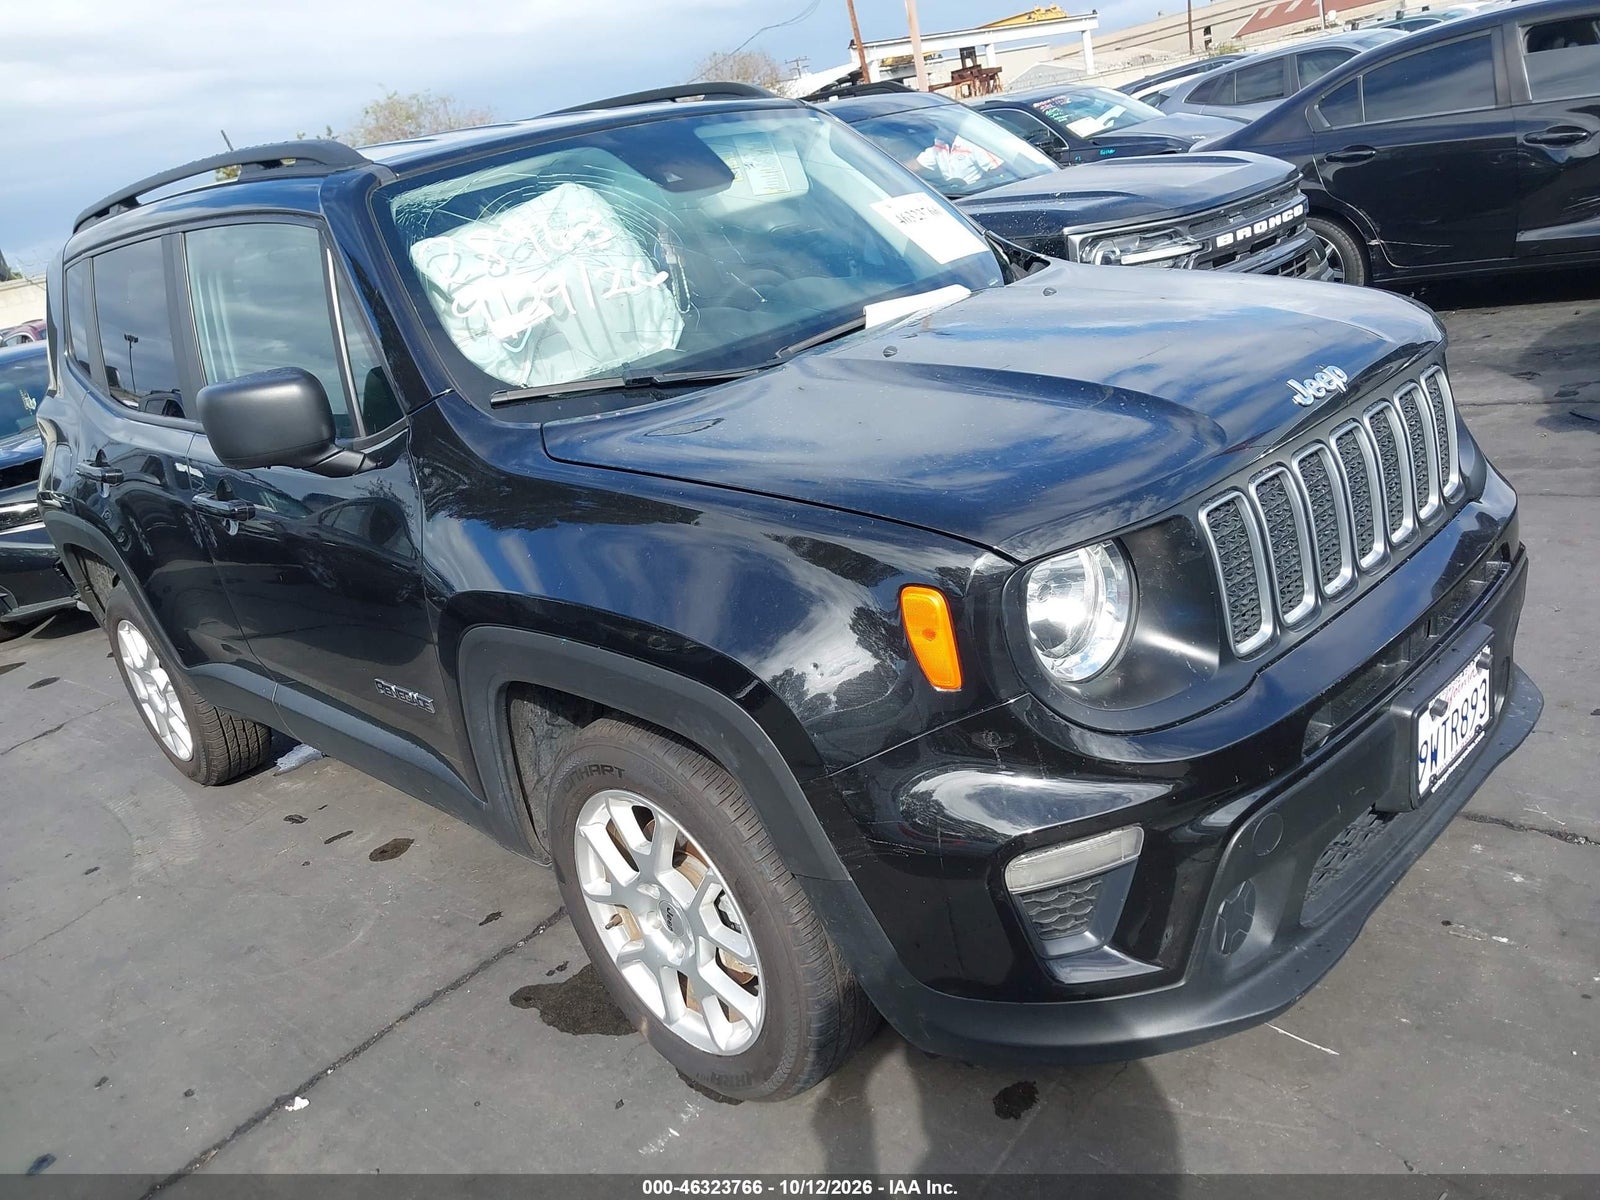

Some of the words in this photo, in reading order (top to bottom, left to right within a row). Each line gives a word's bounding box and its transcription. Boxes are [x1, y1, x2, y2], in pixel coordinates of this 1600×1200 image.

[1216, 204, 1303, 248] BRONCO
[1286, 365, 1348, 407] Jeep
[1418, 678, 1487, 782] 9WTR893
